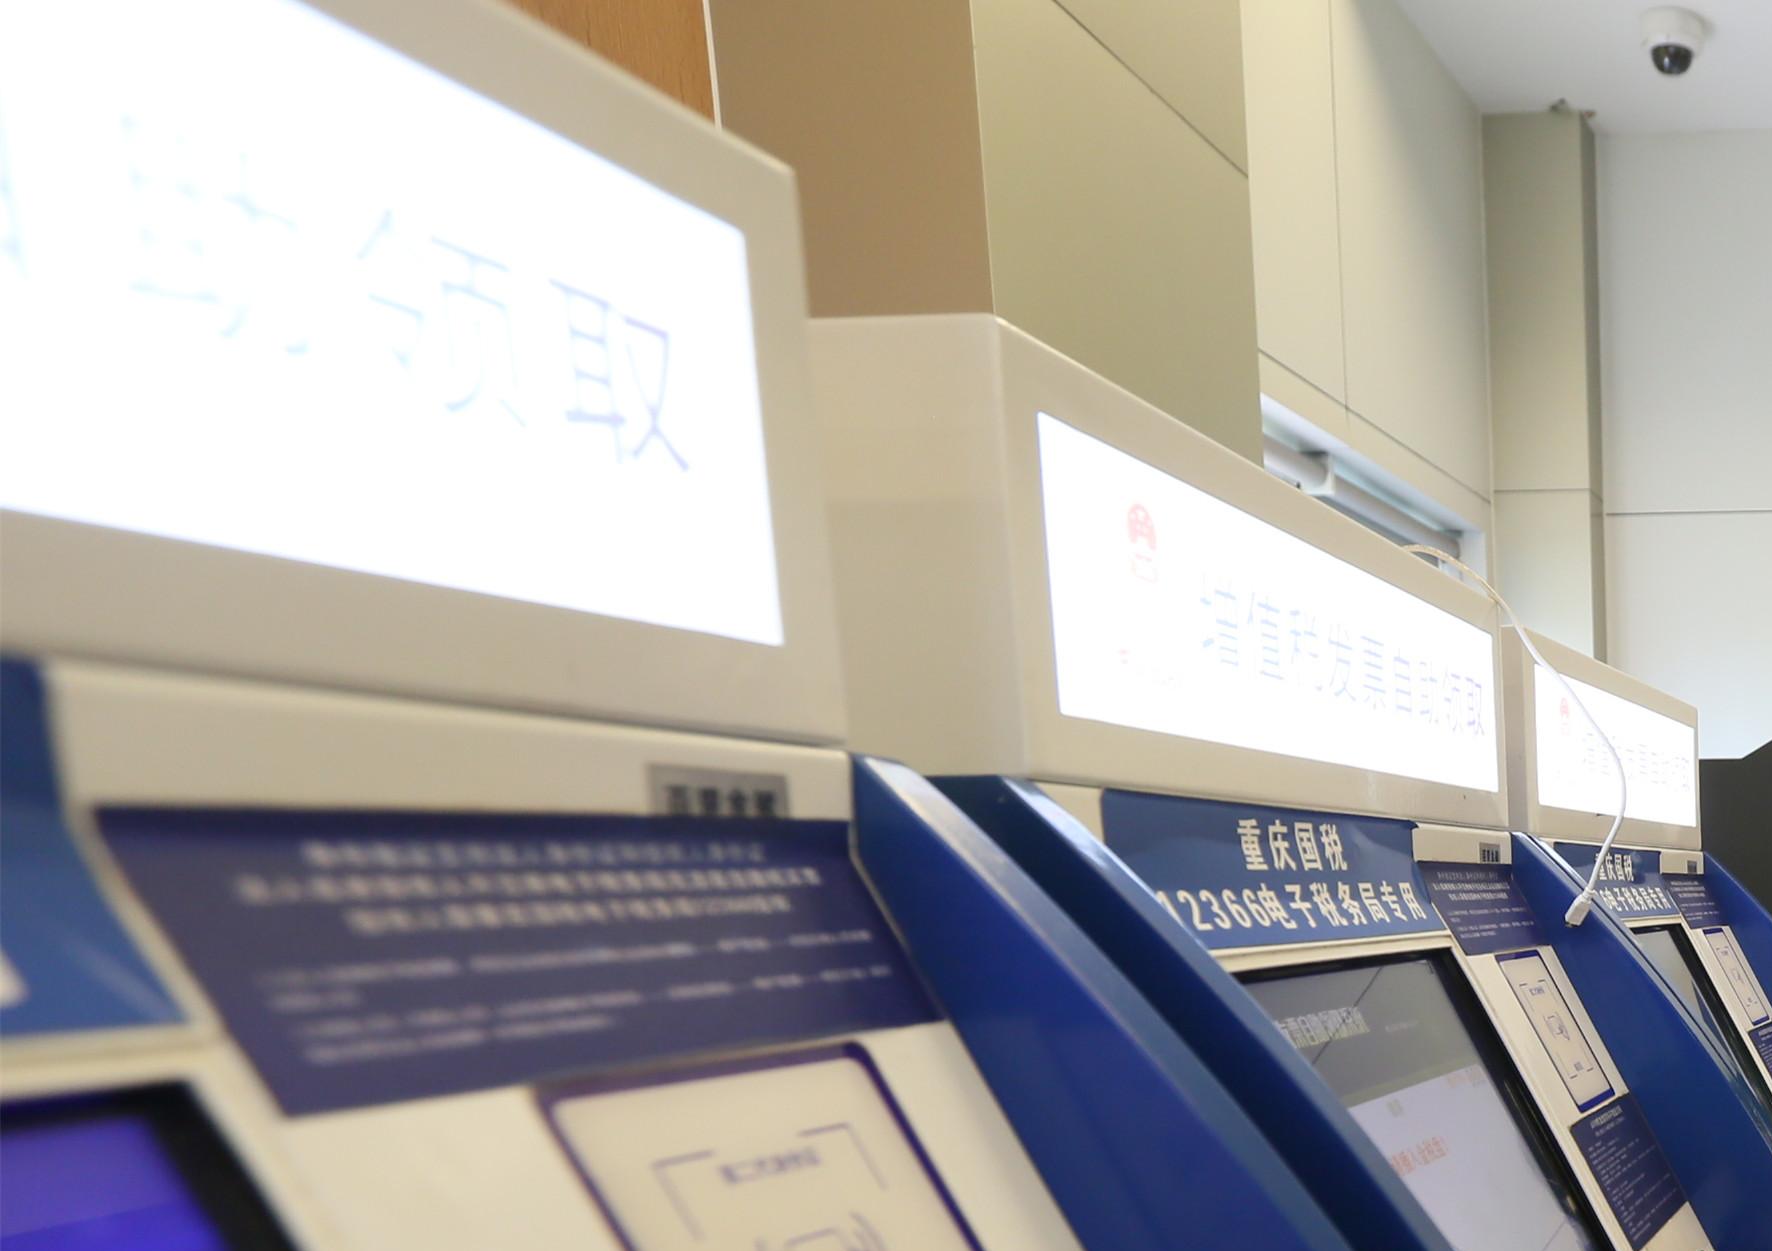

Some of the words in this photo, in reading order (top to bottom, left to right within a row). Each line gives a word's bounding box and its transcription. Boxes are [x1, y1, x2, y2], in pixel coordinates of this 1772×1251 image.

[0, 88, 691, 472] 助领取
[1236, 818, 1349, 872] 重庆国税
[1156, 880, 1428, 932] 12366电子税务局专用
